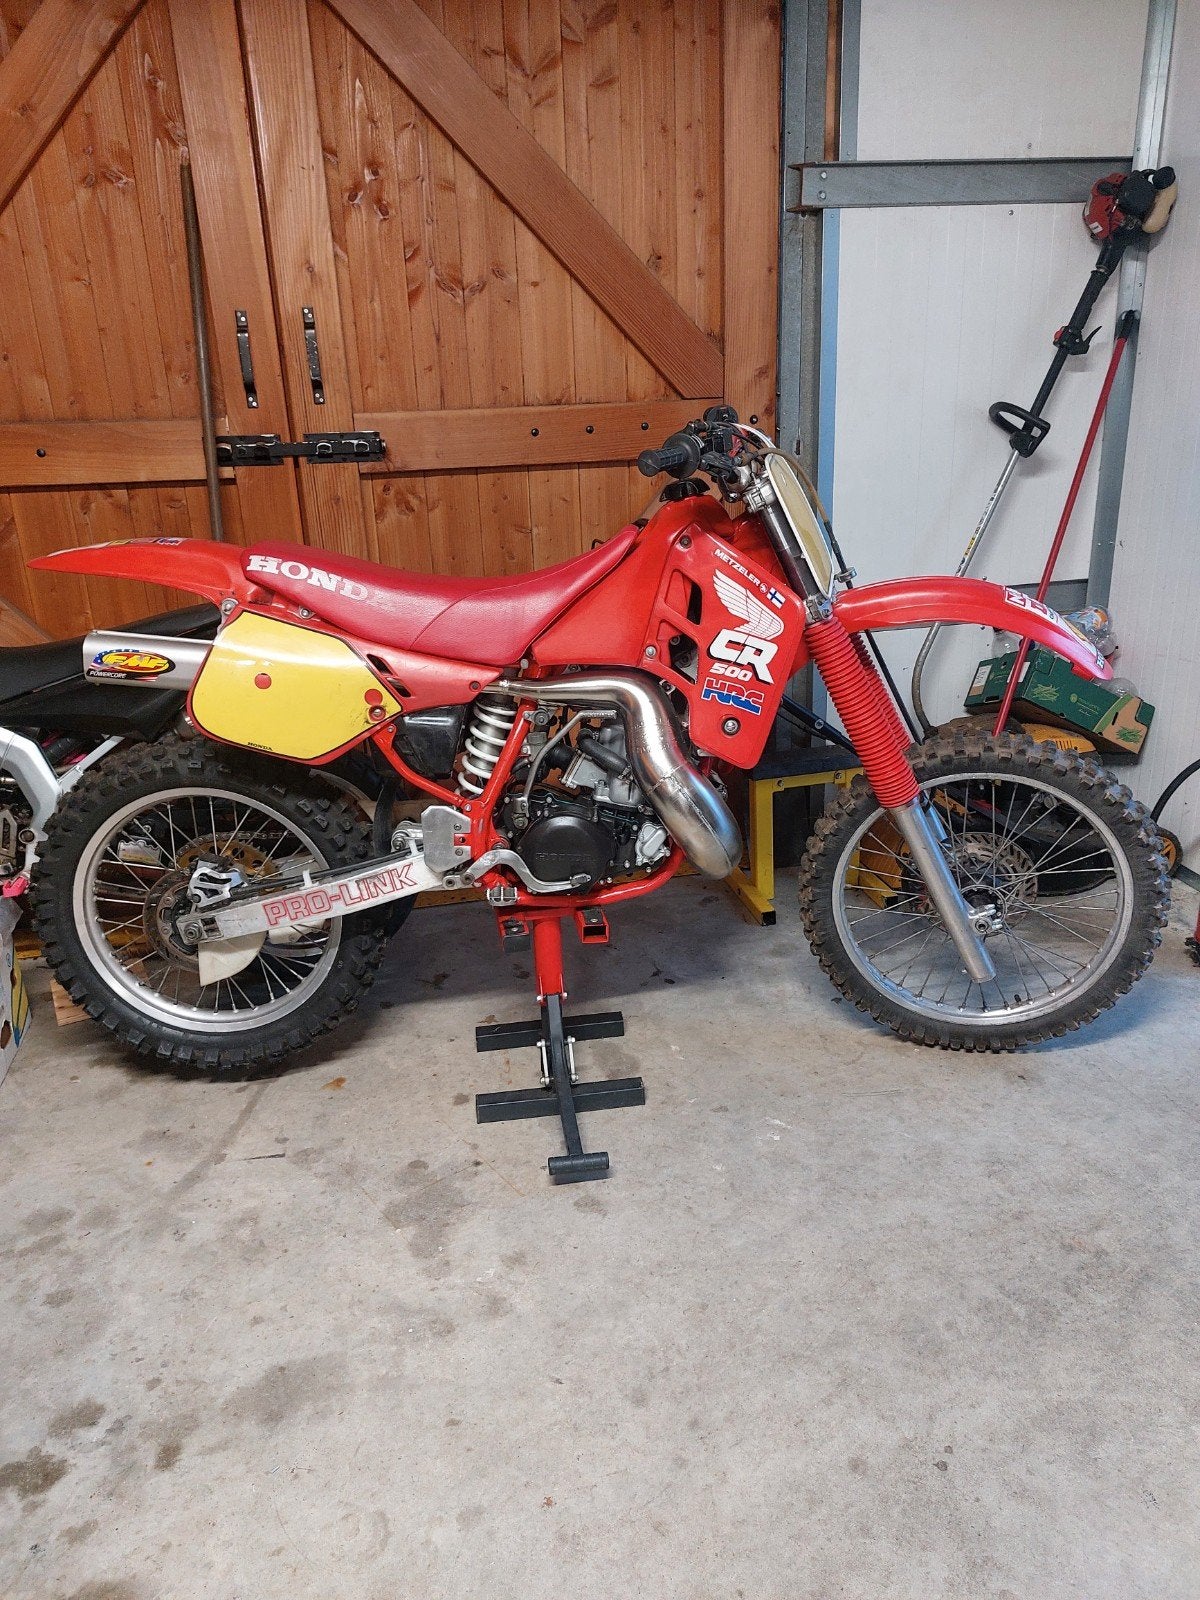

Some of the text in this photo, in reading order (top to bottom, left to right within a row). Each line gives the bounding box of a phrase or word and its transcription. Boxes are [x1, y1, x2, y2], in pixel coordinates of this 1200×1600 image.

[714, 549, 761, 586] METZELER
[103, 655, 168, 668] FMF
[707, 628, 779, 685] CR
[89, 670, 127, 679] POWERCORE
[709, 662, 753, 682] 500
[701, 677, 765, 716] HRC
[247, 741, 273, 751] HONDA
[262, 862, 417, 926] PRO-LINK
